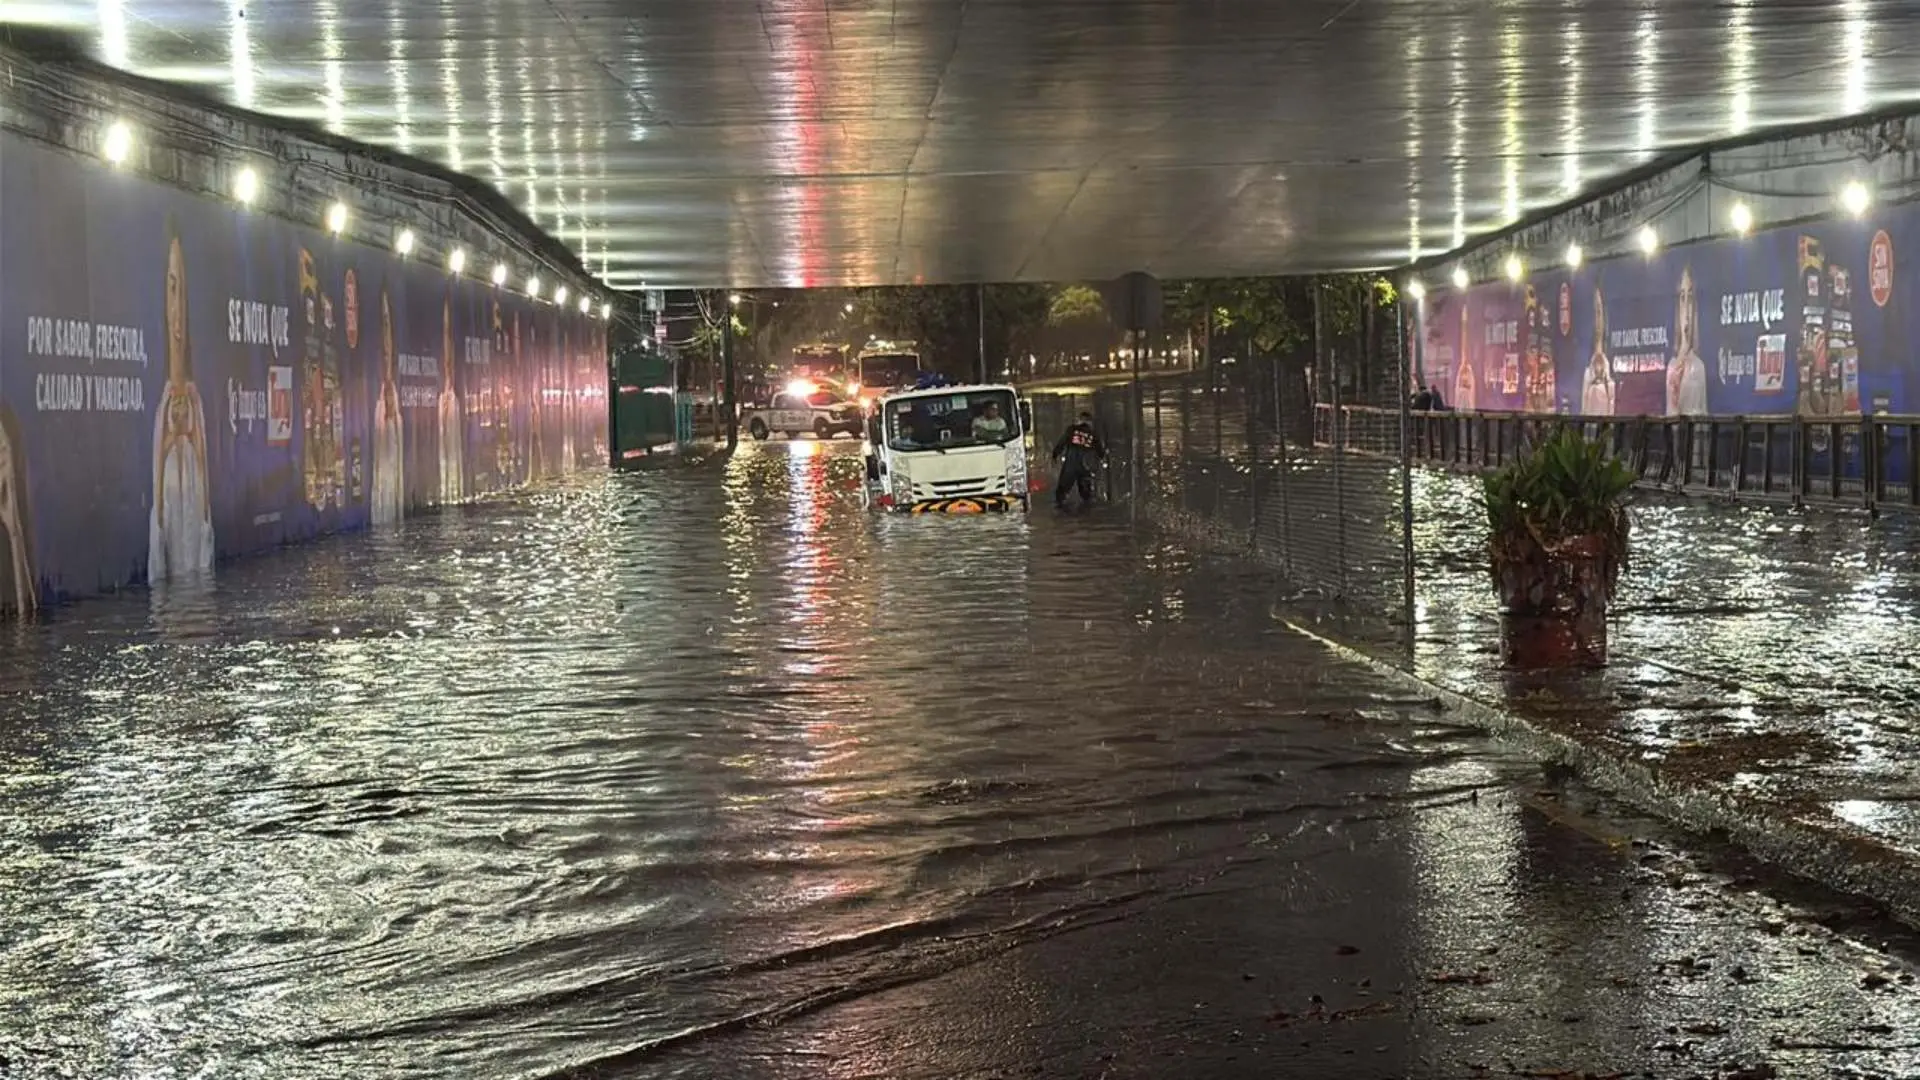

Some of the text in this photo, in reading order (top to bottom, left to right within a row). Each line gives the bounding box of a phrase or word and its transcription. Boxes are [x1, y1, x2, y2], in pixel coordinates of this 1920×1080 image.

[228, 298, 289, 358] SE NOTA QUE
[1721, 294, 1733, 325] SE
[1734, 292, 1759, 324] NOTA
[1762, 289, 1784, 330] QUE
[27, 316, 148, 369] POR SABOR, FRESCURA,
[36, 373, 145, 411] CALIDAD Y VARIEDAD.
